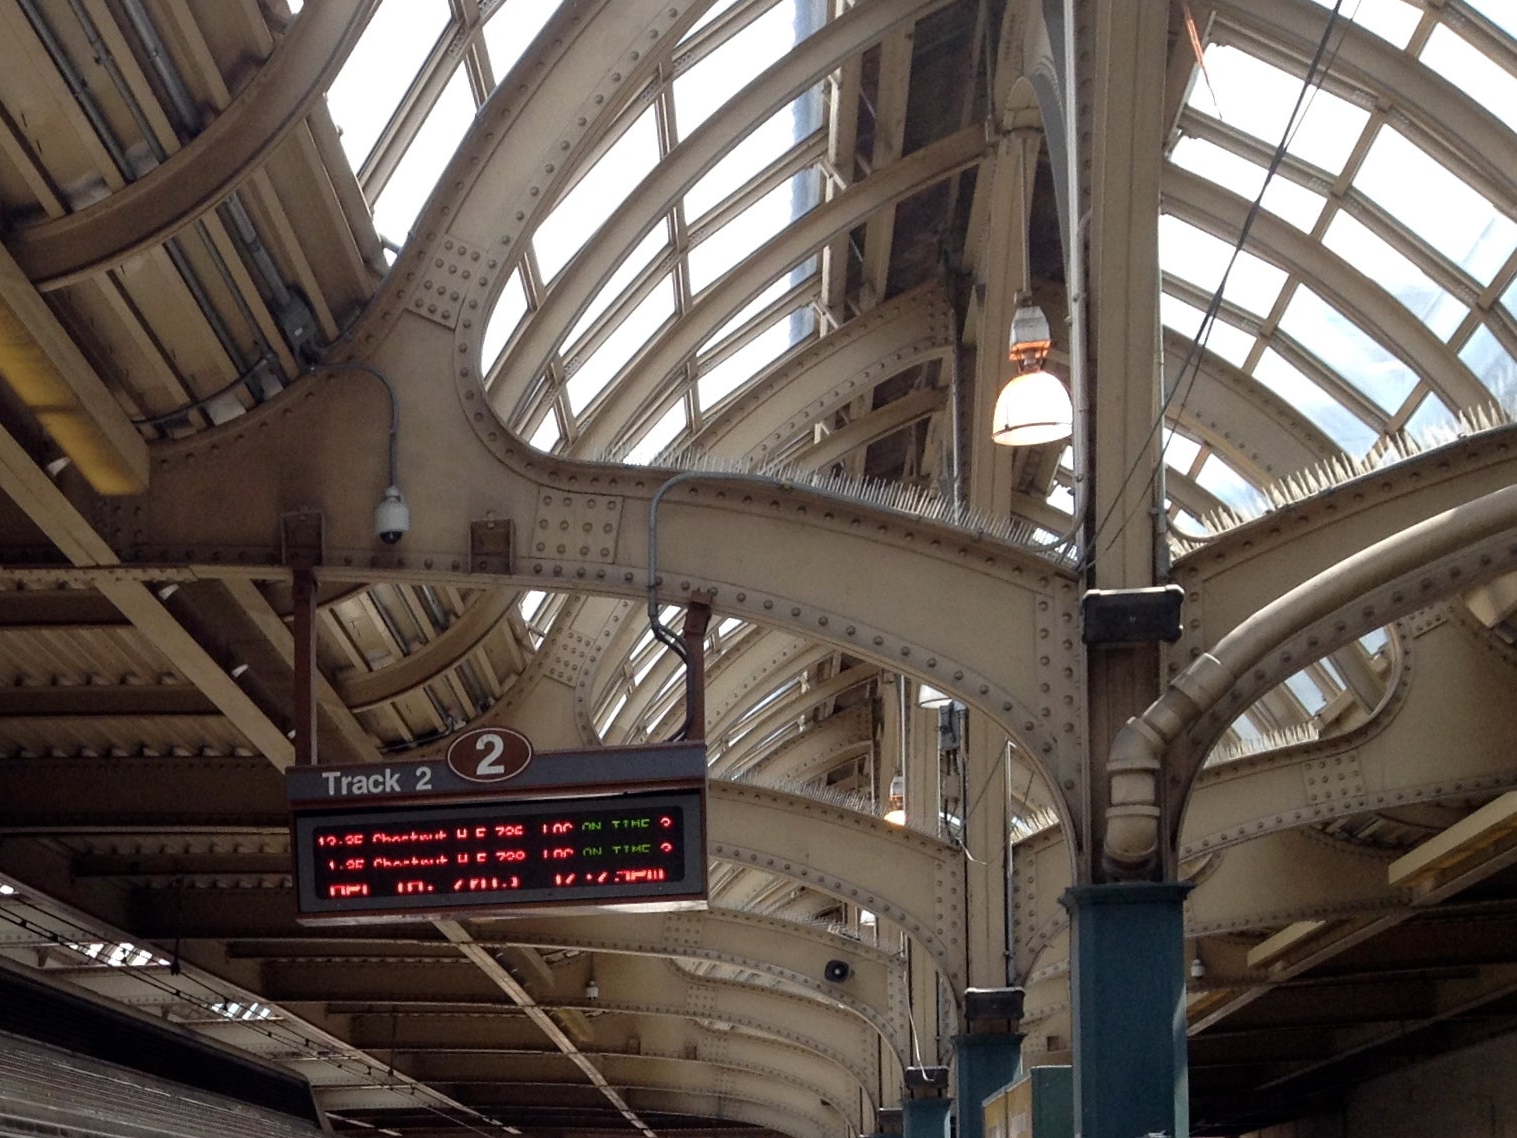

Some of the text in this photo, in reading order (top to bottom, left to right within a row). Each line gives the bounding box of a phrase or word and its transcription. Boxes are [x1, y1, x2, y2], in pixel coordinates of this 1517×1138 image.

[474, 733, 505, 776] 2
[321, 766, 432, 796] Track 2
